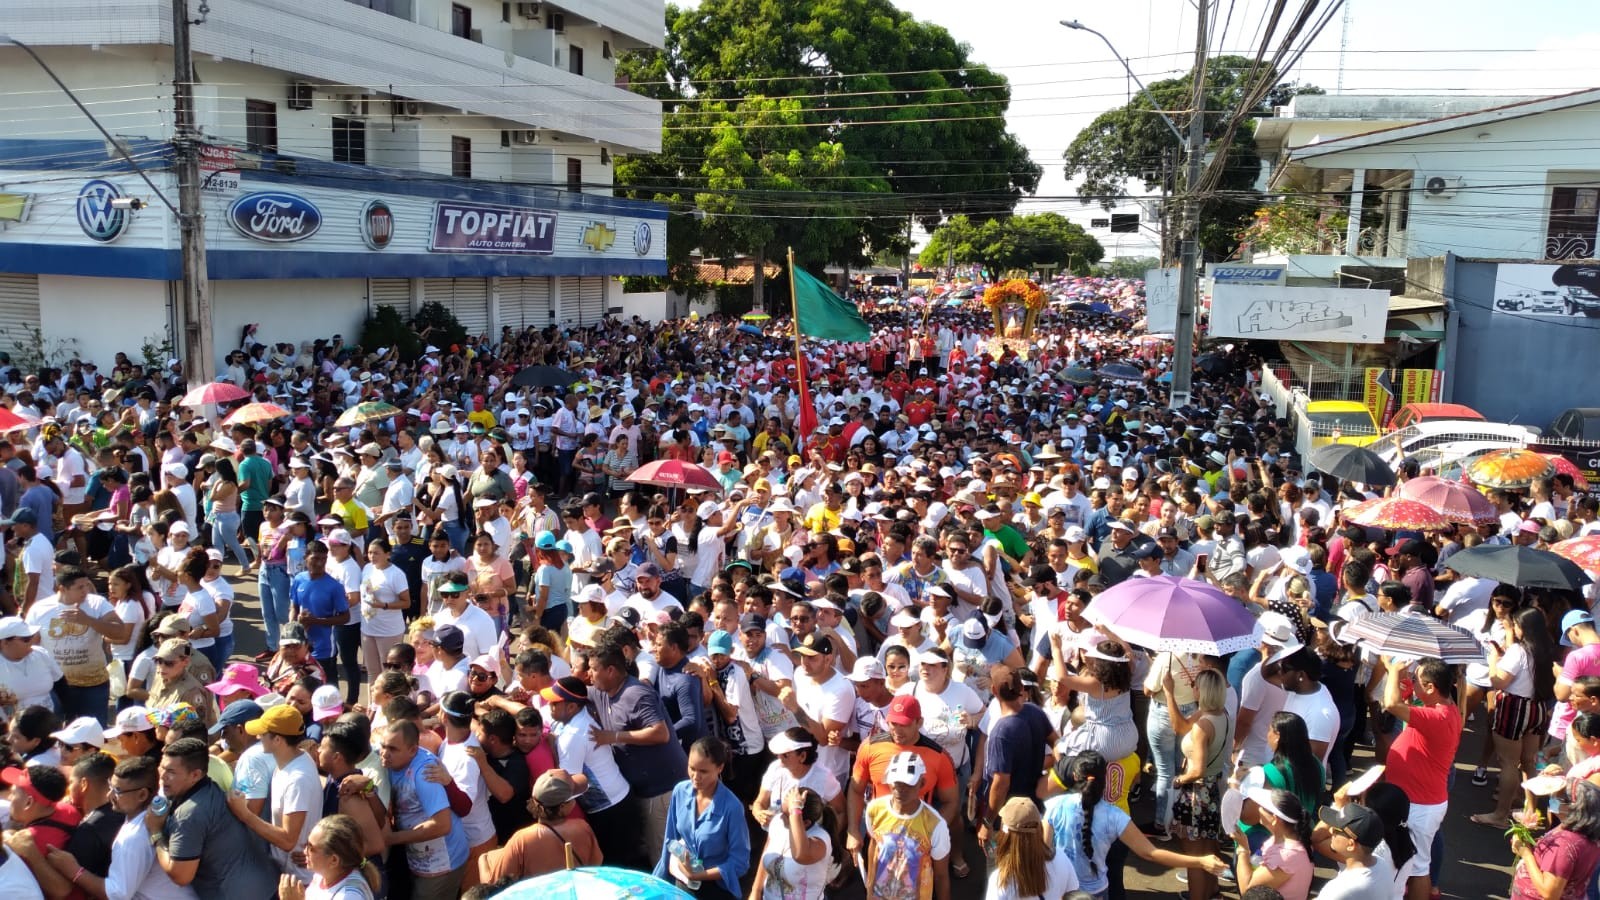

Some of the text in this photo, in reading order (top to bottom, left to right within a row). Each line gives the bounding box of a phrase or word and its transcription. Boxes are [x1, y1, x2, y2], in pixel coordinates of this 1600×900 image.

[250, 199, 306, 234] Ford
[371, 215, 389, 236] FIAT
[444, 209, 552, 239] TOPFIAT
[468, 240, 493, 248] AUTO
[1215, 268, 1278, 277] TOPFIAT
